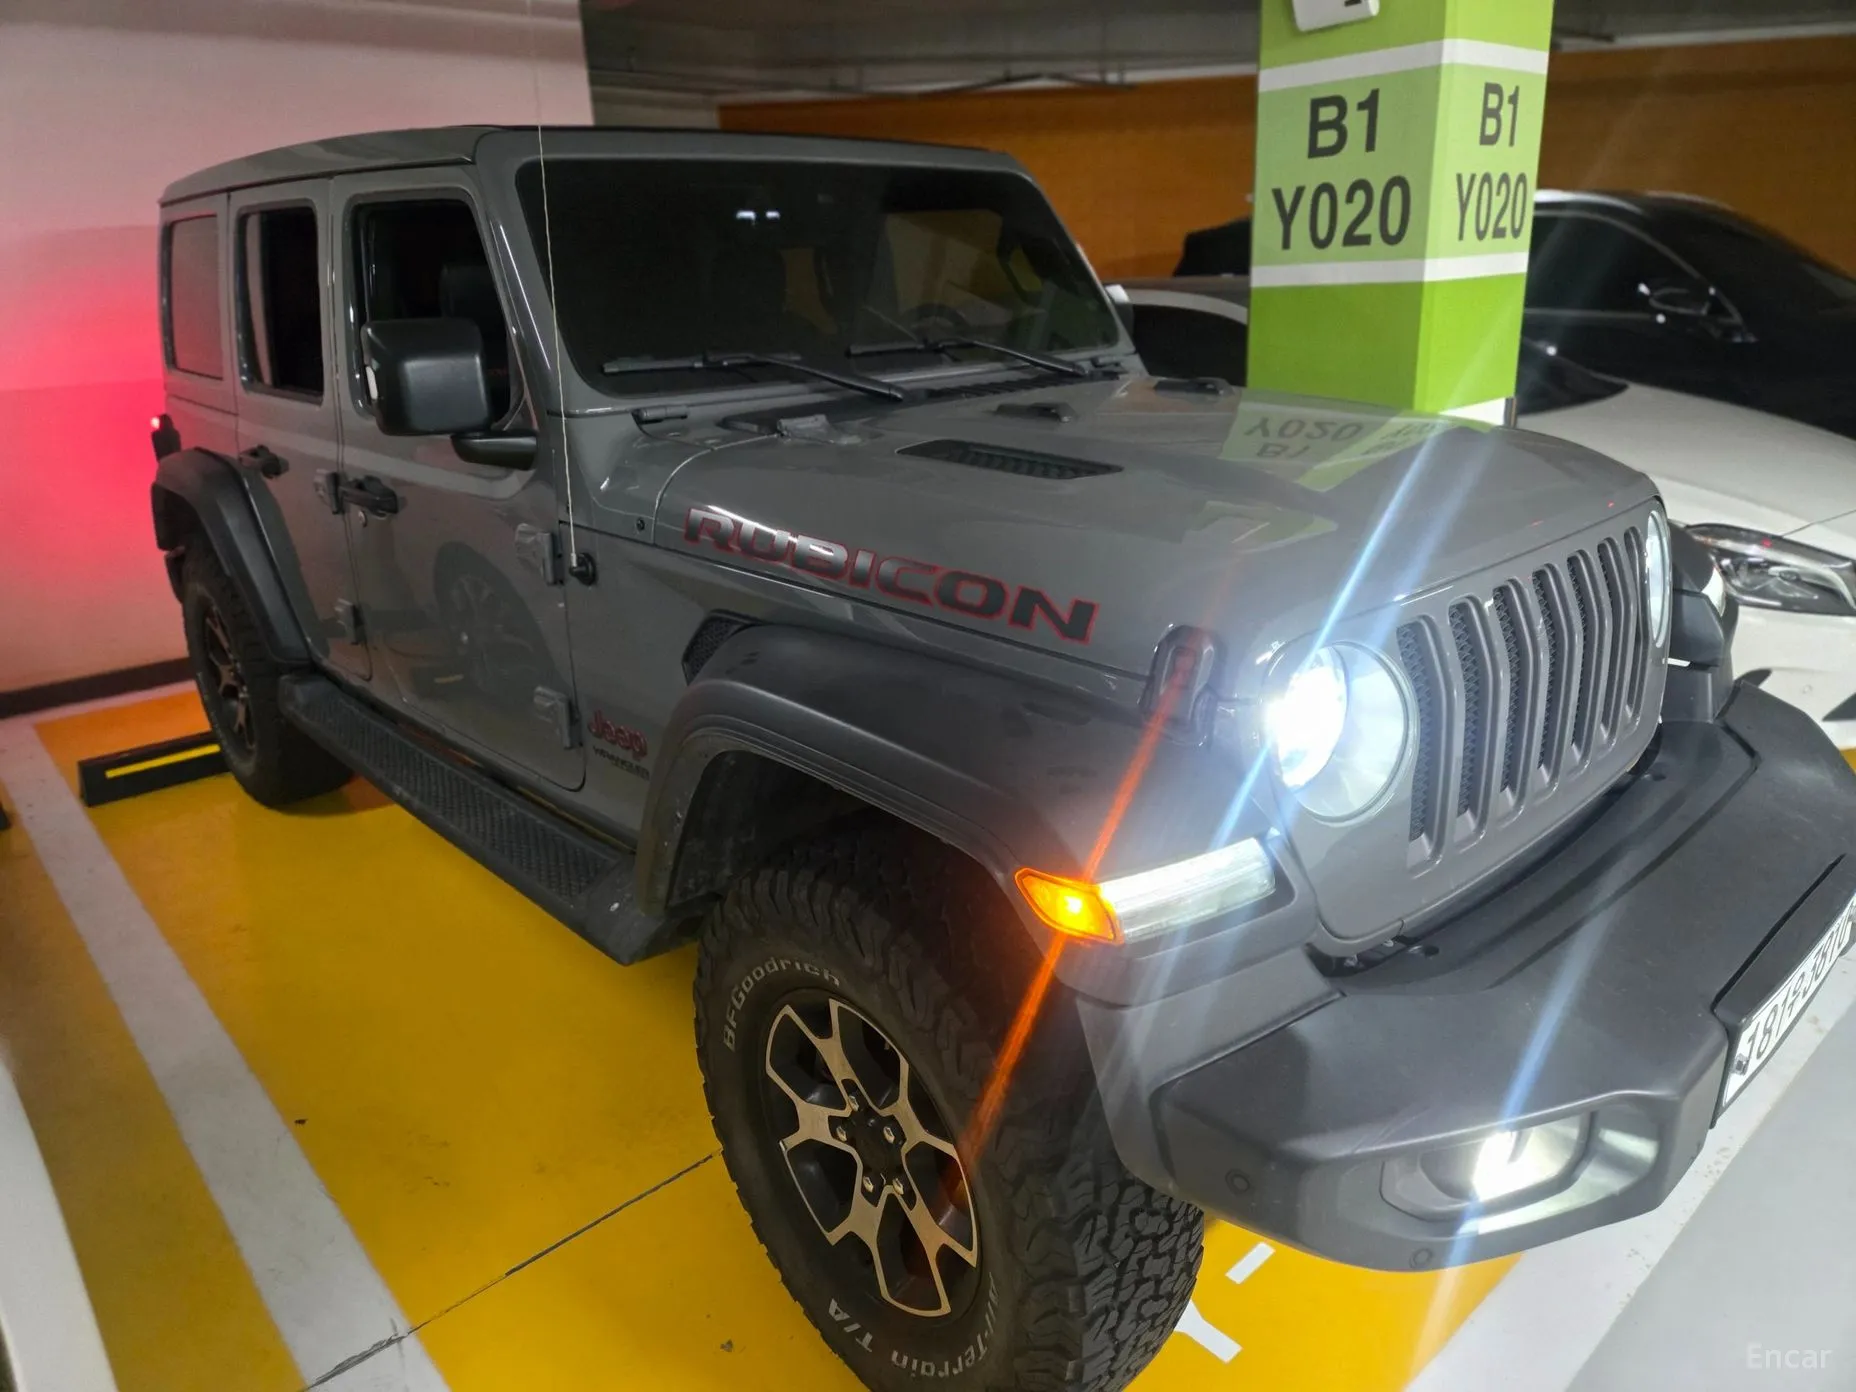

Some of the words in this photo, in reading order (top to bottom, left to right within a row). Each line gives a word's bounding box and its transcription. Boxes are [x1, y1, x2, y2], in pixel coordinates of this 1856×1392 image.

[1307, 88, 1380, 159] B1
[1478, 82, 1520, 147] B1
[1271, 175, 1412, 250] Y020
[1455, 171, 1528, 242] Y020
[683, 505, 1100, 646] RUBICON
[586, 709, 648, 762] Jeep
[722, 957, 840, 1052] BFGoodrich
